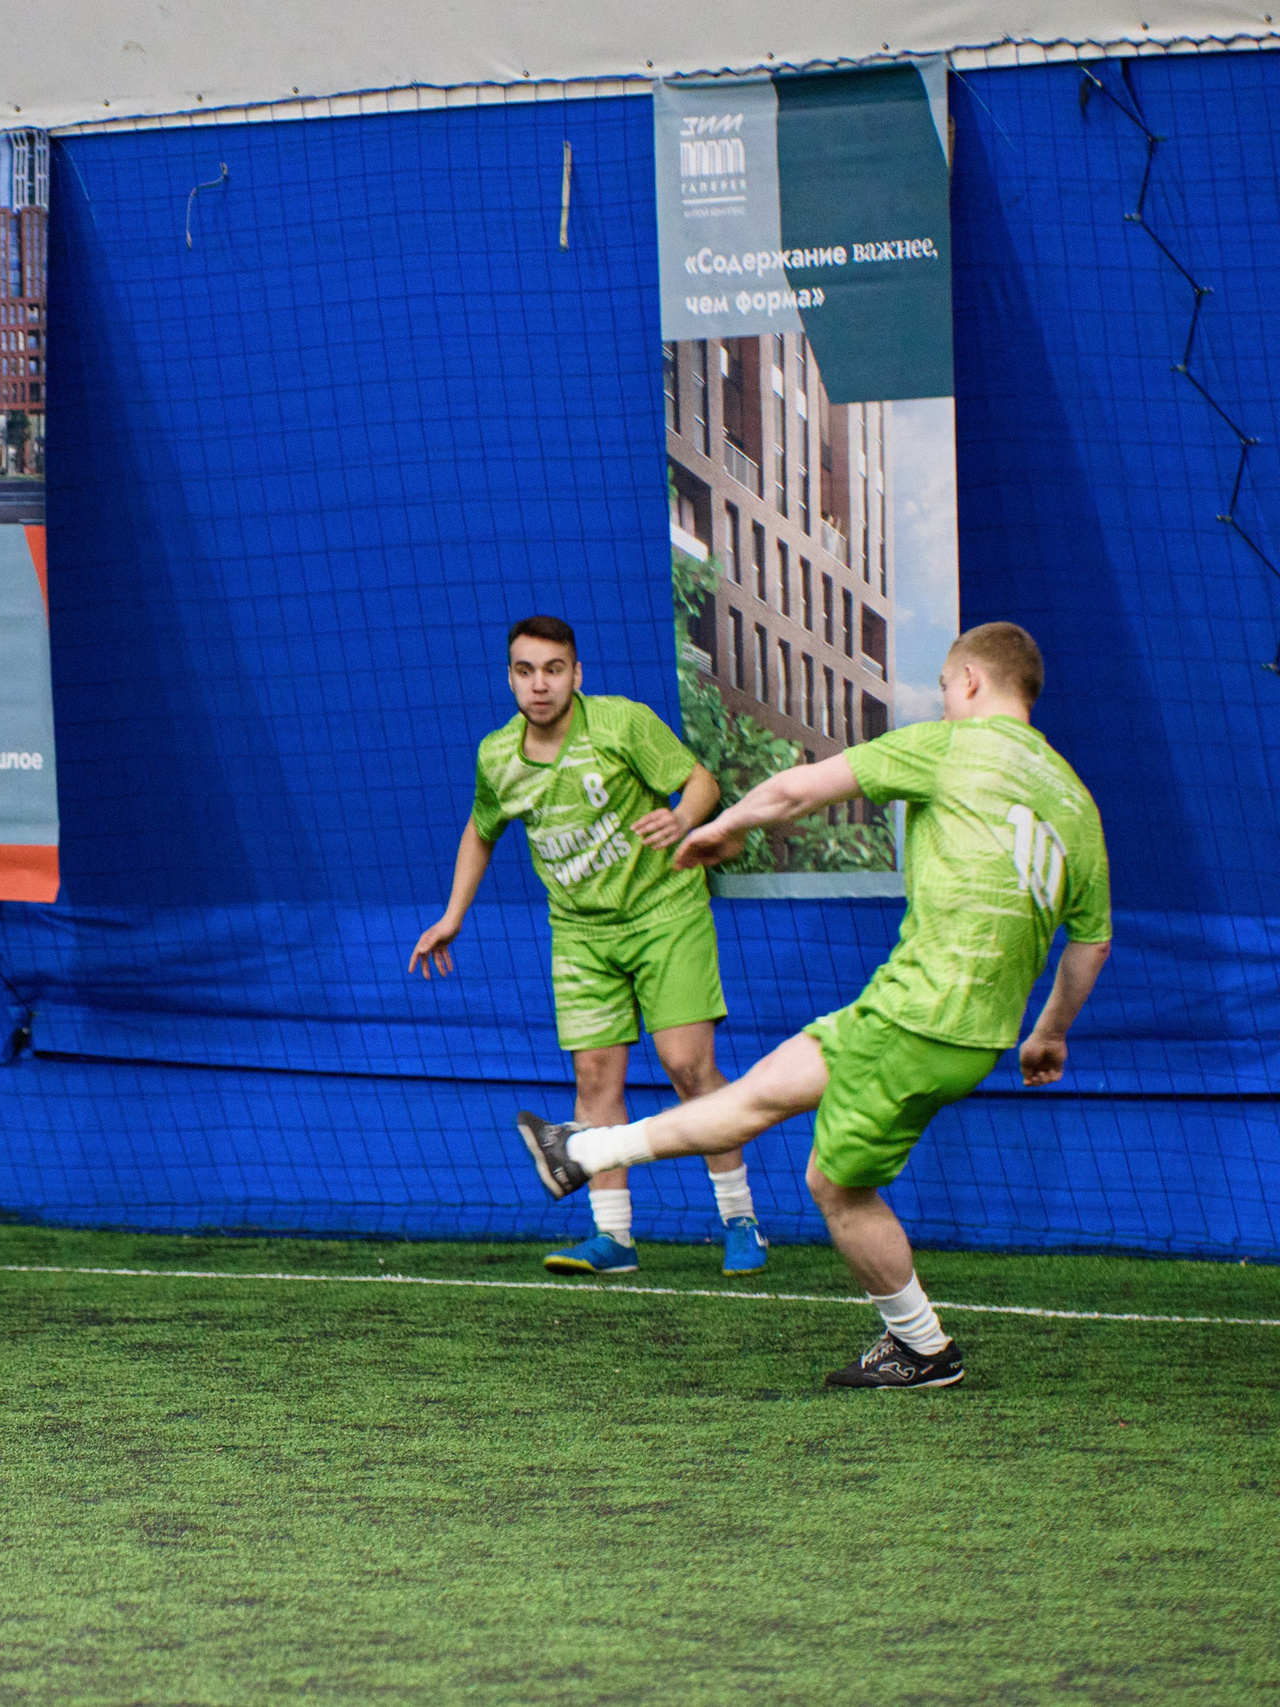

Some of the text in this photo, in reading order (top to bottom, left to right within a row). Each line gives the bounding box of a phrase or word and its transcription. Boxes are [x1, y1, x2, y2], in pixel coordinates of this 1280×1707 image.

[684, 238, 939, 278] «Содержание важнее,
[686, 287, 825, 317] чем форма»
[582, 773, 609, 808] 8
[1007, 803, 1067, 911] 10
